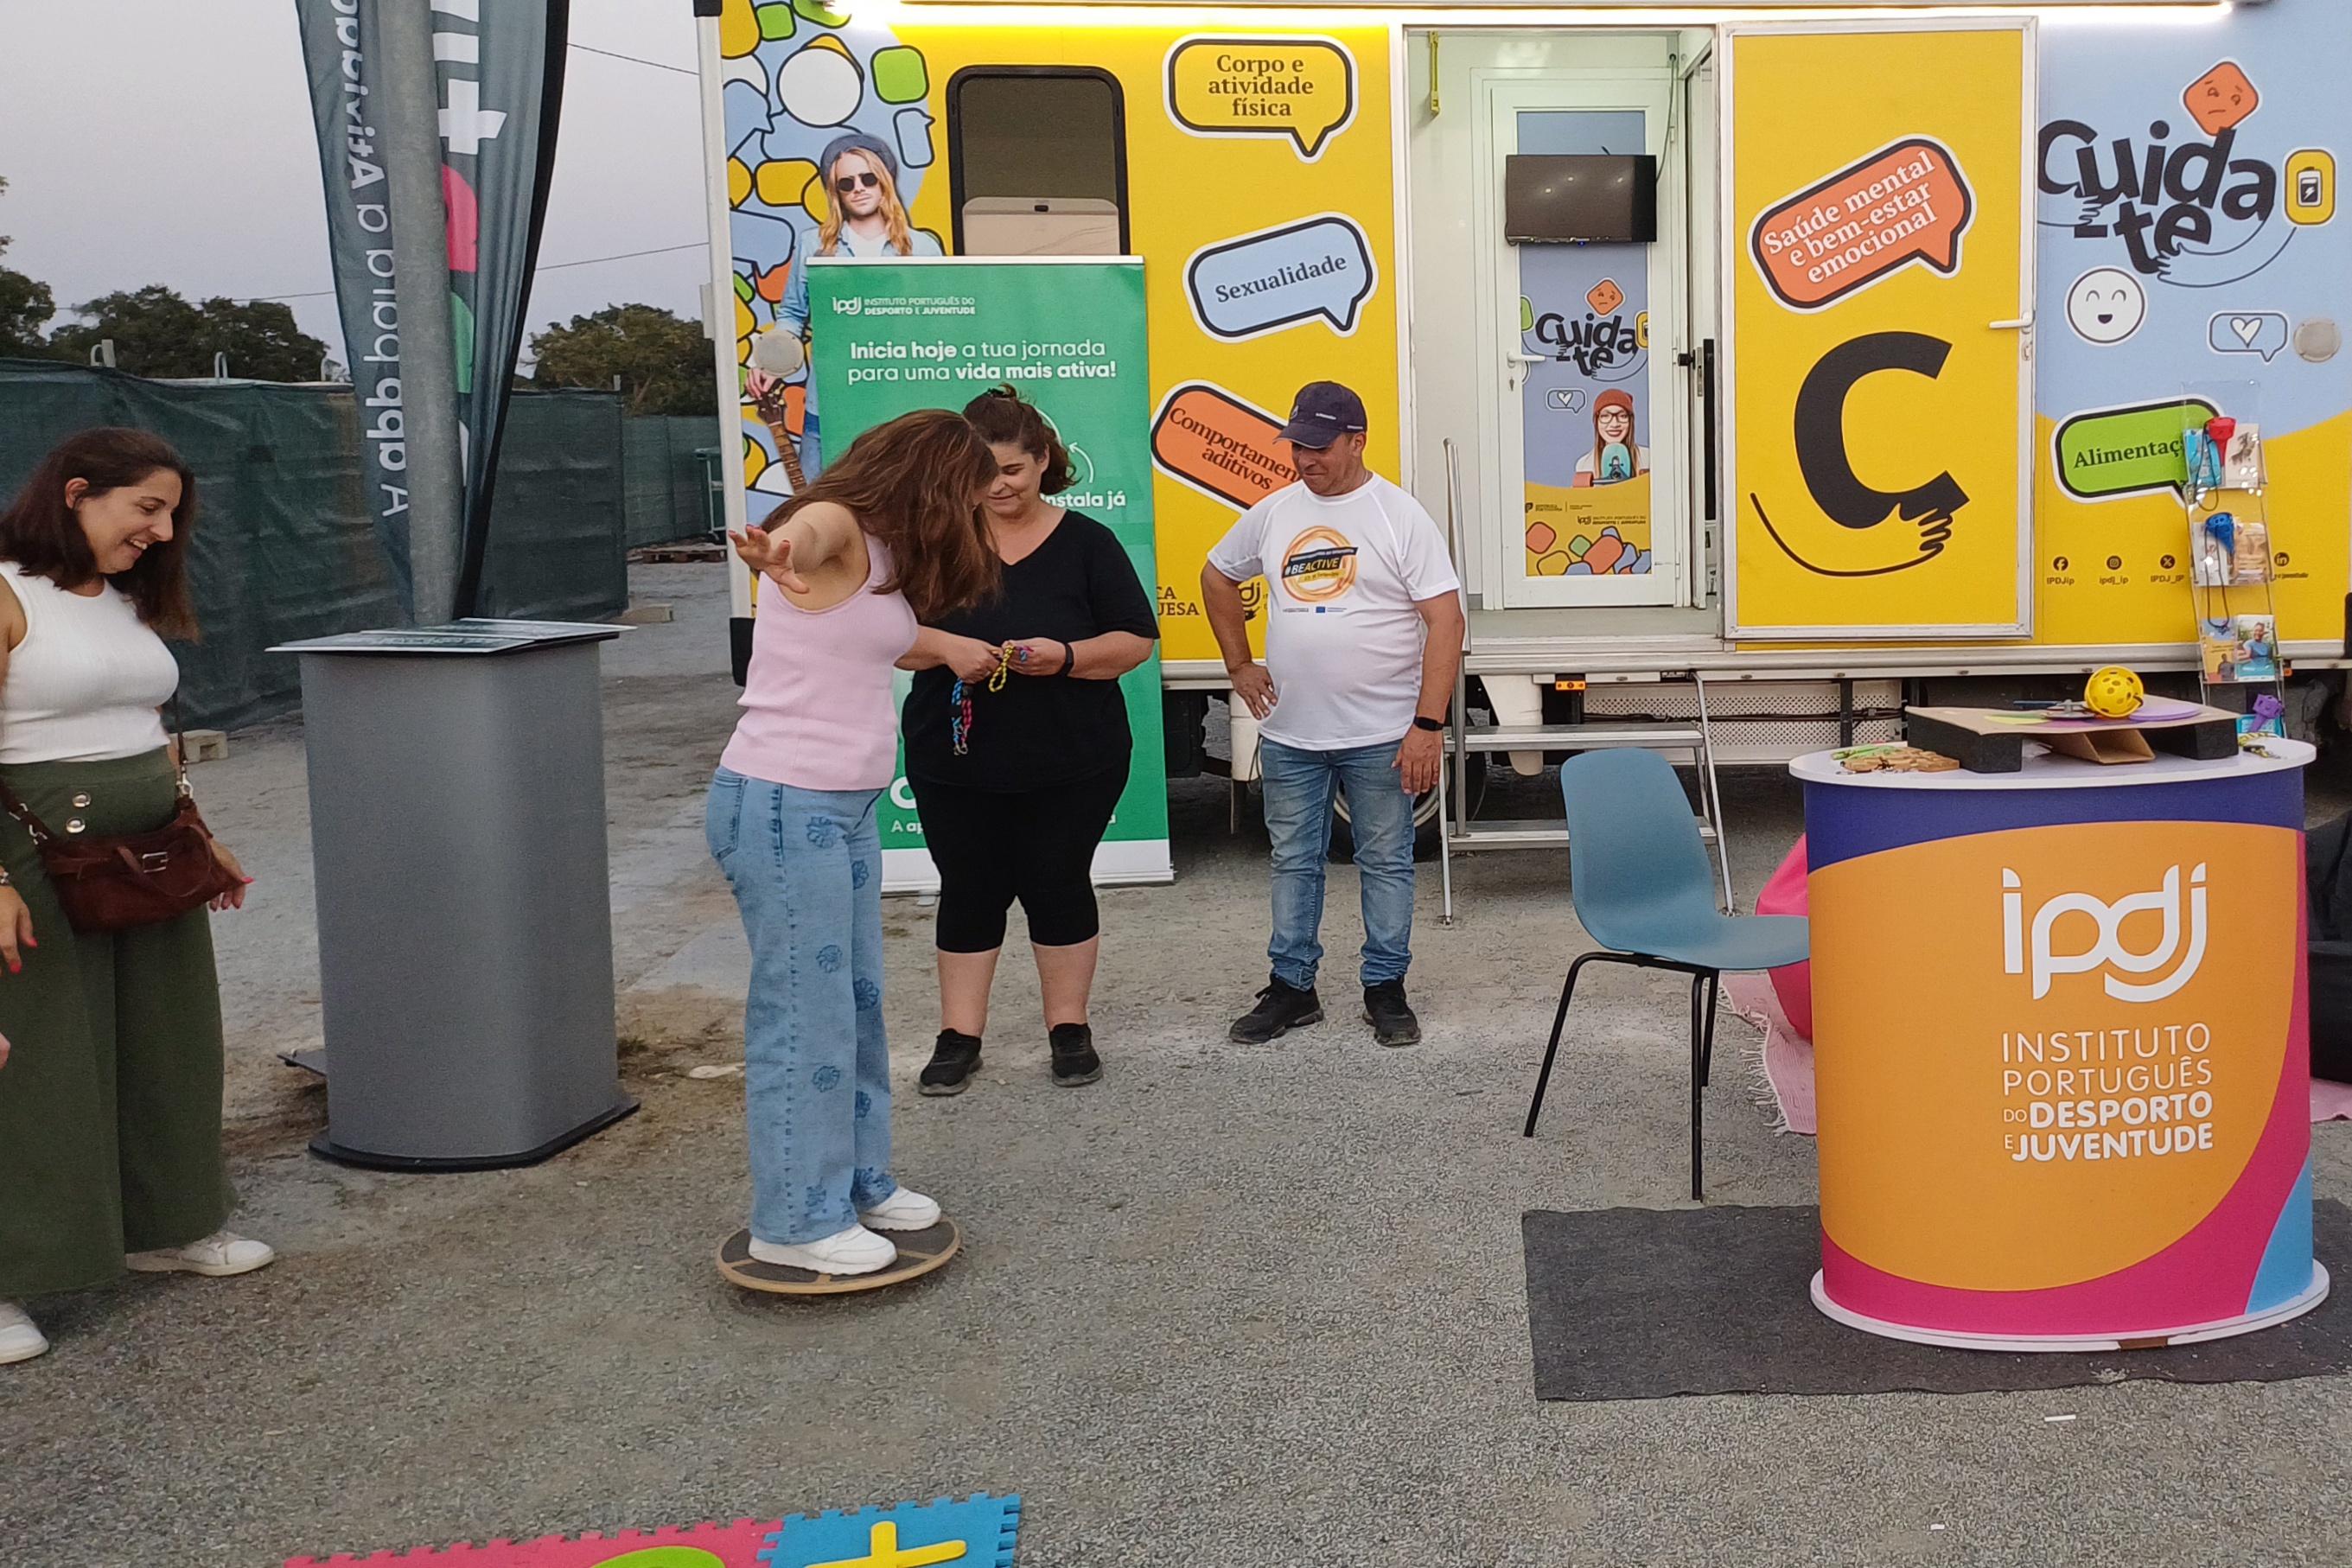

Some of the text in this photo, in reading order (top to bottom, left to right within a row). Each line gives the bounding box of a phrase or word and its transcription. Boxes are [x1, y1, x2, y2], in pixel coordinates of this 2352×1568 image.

[1208, 76, 1315, 94] atividade
[1216, 54, 1304, 77] Corpo e
[1232, 97, 1292, 117] física
[2037, 119, 2277, 221] Cuida
[1763, 150, 1935, 255] Saúde mental
[1789, 182, 1932, 267] e bem-estar
[1807, 201, 1938, 284] emocional
[1214, 255, 1348, 303] Sexualidade
[832, 296, 862, 316] ipdj
[864, 306, 913, 316] DESPORTO
[921, 306, 976, 315] JUVENTUDE
[850, 338, 1106, 362] Inicia hoje a tua jornada
[1535, 312, 1639, 354] Cuida
[847, 360, 1117, 386] para uma vida mais ativa!
[1170, 407, 1300, 483] Comportamen
[1794, 331, 1970, 530] C
[1201, 446, 1273, 490] aditivos
[2073, 438, 2184, 468] Alimentaç
[1106, 489, 1126, 510] já
[891, 821, 903, 832] A
[2001, 862, 2208, 1003] ipdj
[2002, 1023, 2211, 1063] INSTITUTO
[2003, 1055, 2213, 1097] PORTUGUÊS
[2004, 1091, 2214, 1129] DO DESPORTO
[2005, 1122, 2215, 1162] E JUVENTUDE
